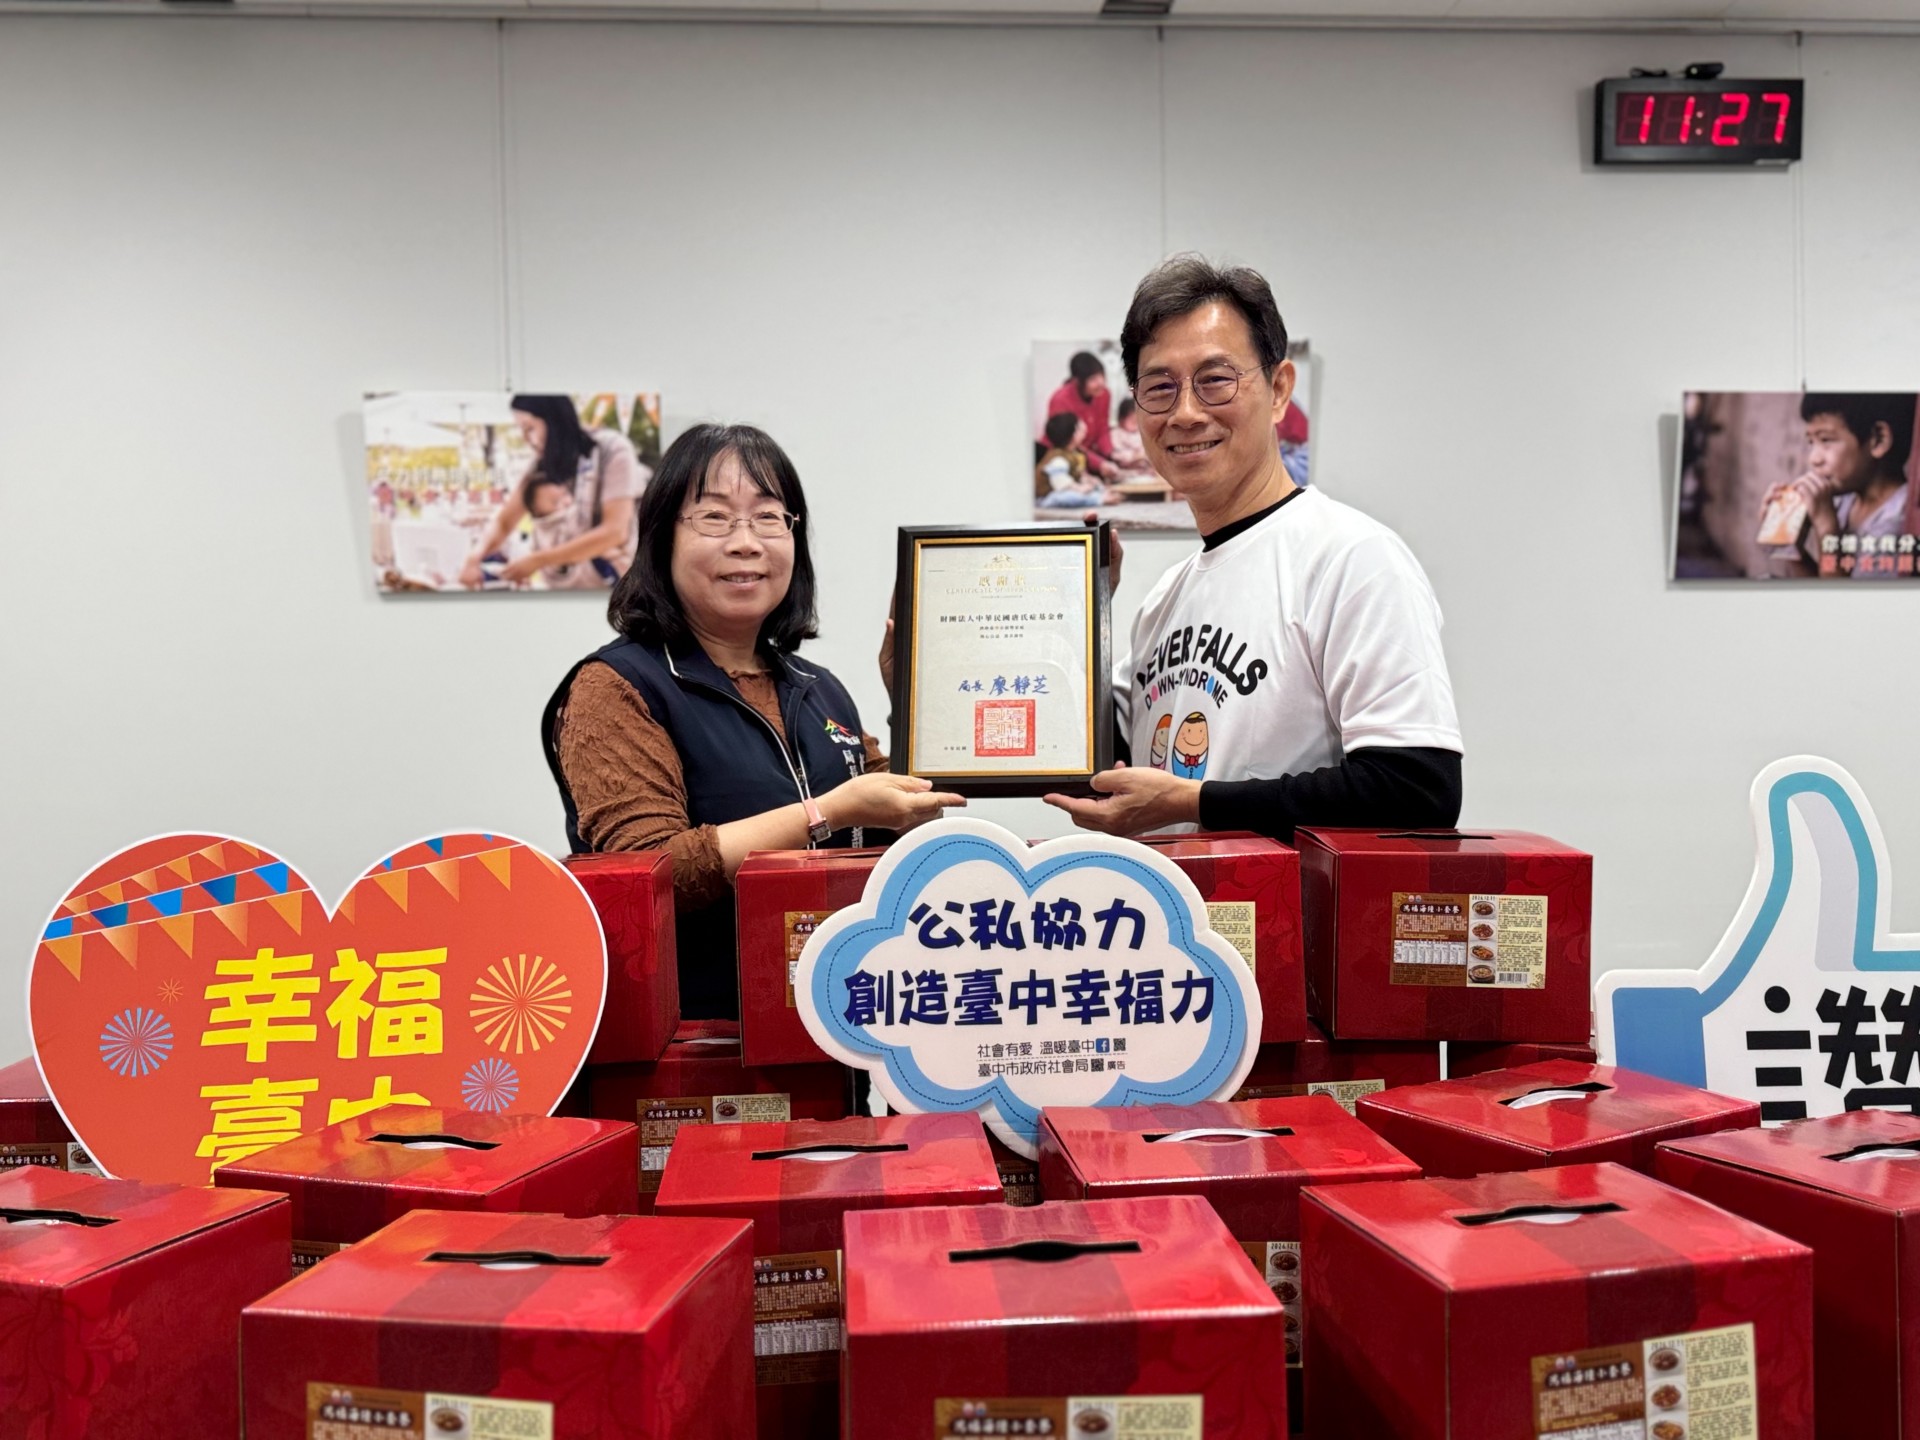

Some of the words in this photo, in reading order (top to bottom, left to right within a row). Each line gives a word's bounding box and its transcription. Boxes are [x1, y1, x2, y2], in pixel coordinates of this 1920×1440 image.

[1639, 93, 1790, 146] 11:27
[958, 680, 984, 693] 局長
[989, 674, 1050, 697] 廖靜芝
[1192, 624, 1268, 696] FALLS
[908, 897, 1147, 952] 公私協力
[200, 947, 448, 1063] 幸福
[842, 967, 1215, 1027] 創造臺中幸福力
[977, 1041, 1033, 1058] 社會有愛
[1039, 1039, 1095, 1056] 溫暖臺中
[978, 1058, 1088, 1077] 臺中市政府社會局
[1107, 1060, 1126, 1071] 廣告
